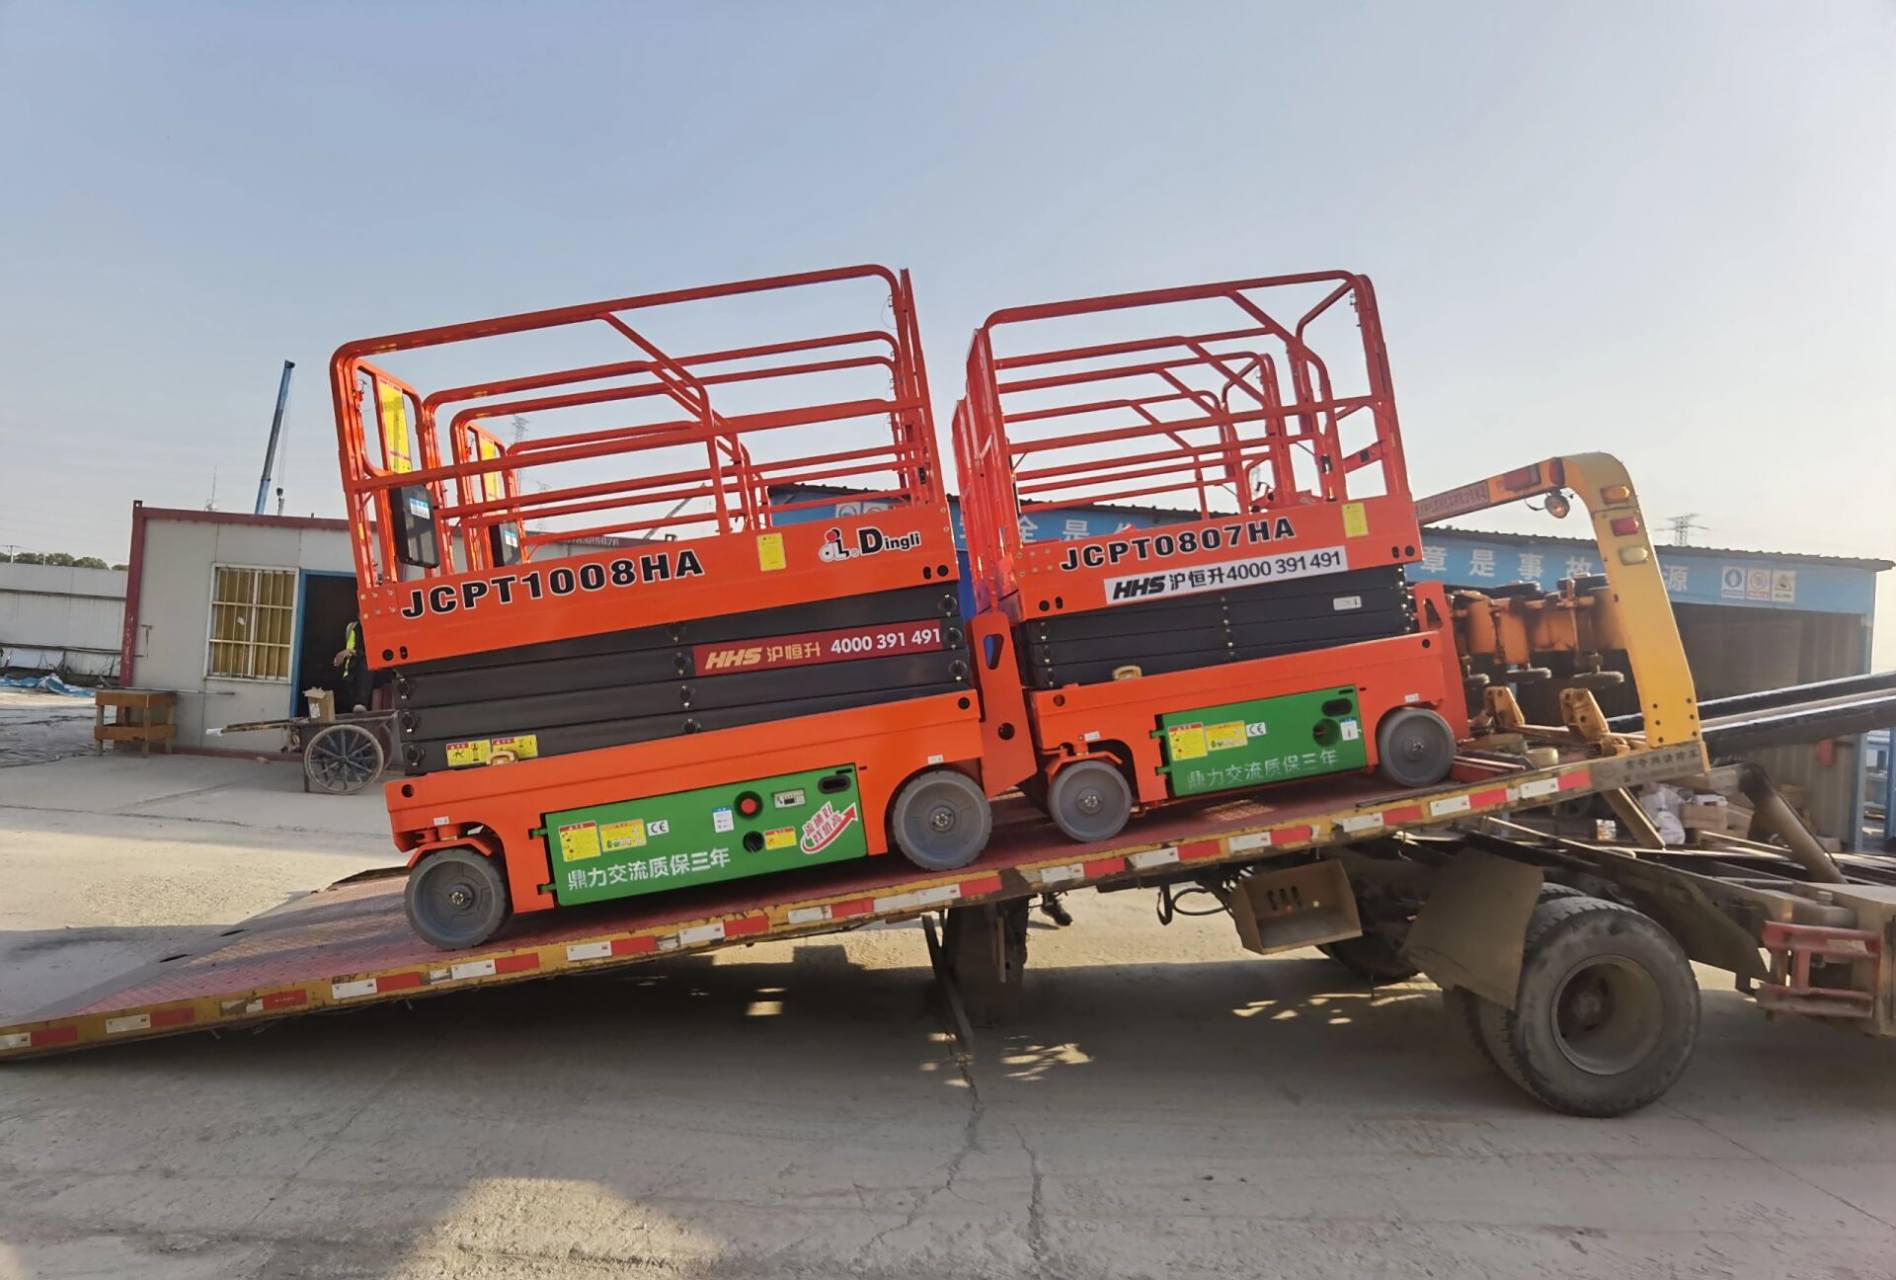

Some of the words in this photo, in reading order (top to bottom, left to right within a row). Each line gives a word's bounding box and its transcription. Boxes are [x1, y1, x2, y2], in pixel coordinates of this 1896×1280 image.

[857, 527, 921, 556] Dingli
[1060, 517, 1296, 572] JCPT0807HA
[401, 549, 704, 619] JCPT1008HA
[1112, 575, 1166, 600] HHS
[1169, 567, 1225, 590] 沪恒升
[1226, 560, 1272, 580] 4000
[1276, 556, 1306, 574] 391
[1310, 550, 1341, 568] 491
[704, 647, 763, 670] HHS
[766, 641, 821, 662] 沪恒升
[830, 635, 872, 654] 4000
[876, 632, 906, 650] 391
[911, 628, 941, 645] 491
[567, 847, 730, 891] 鼎力交流质保三年
